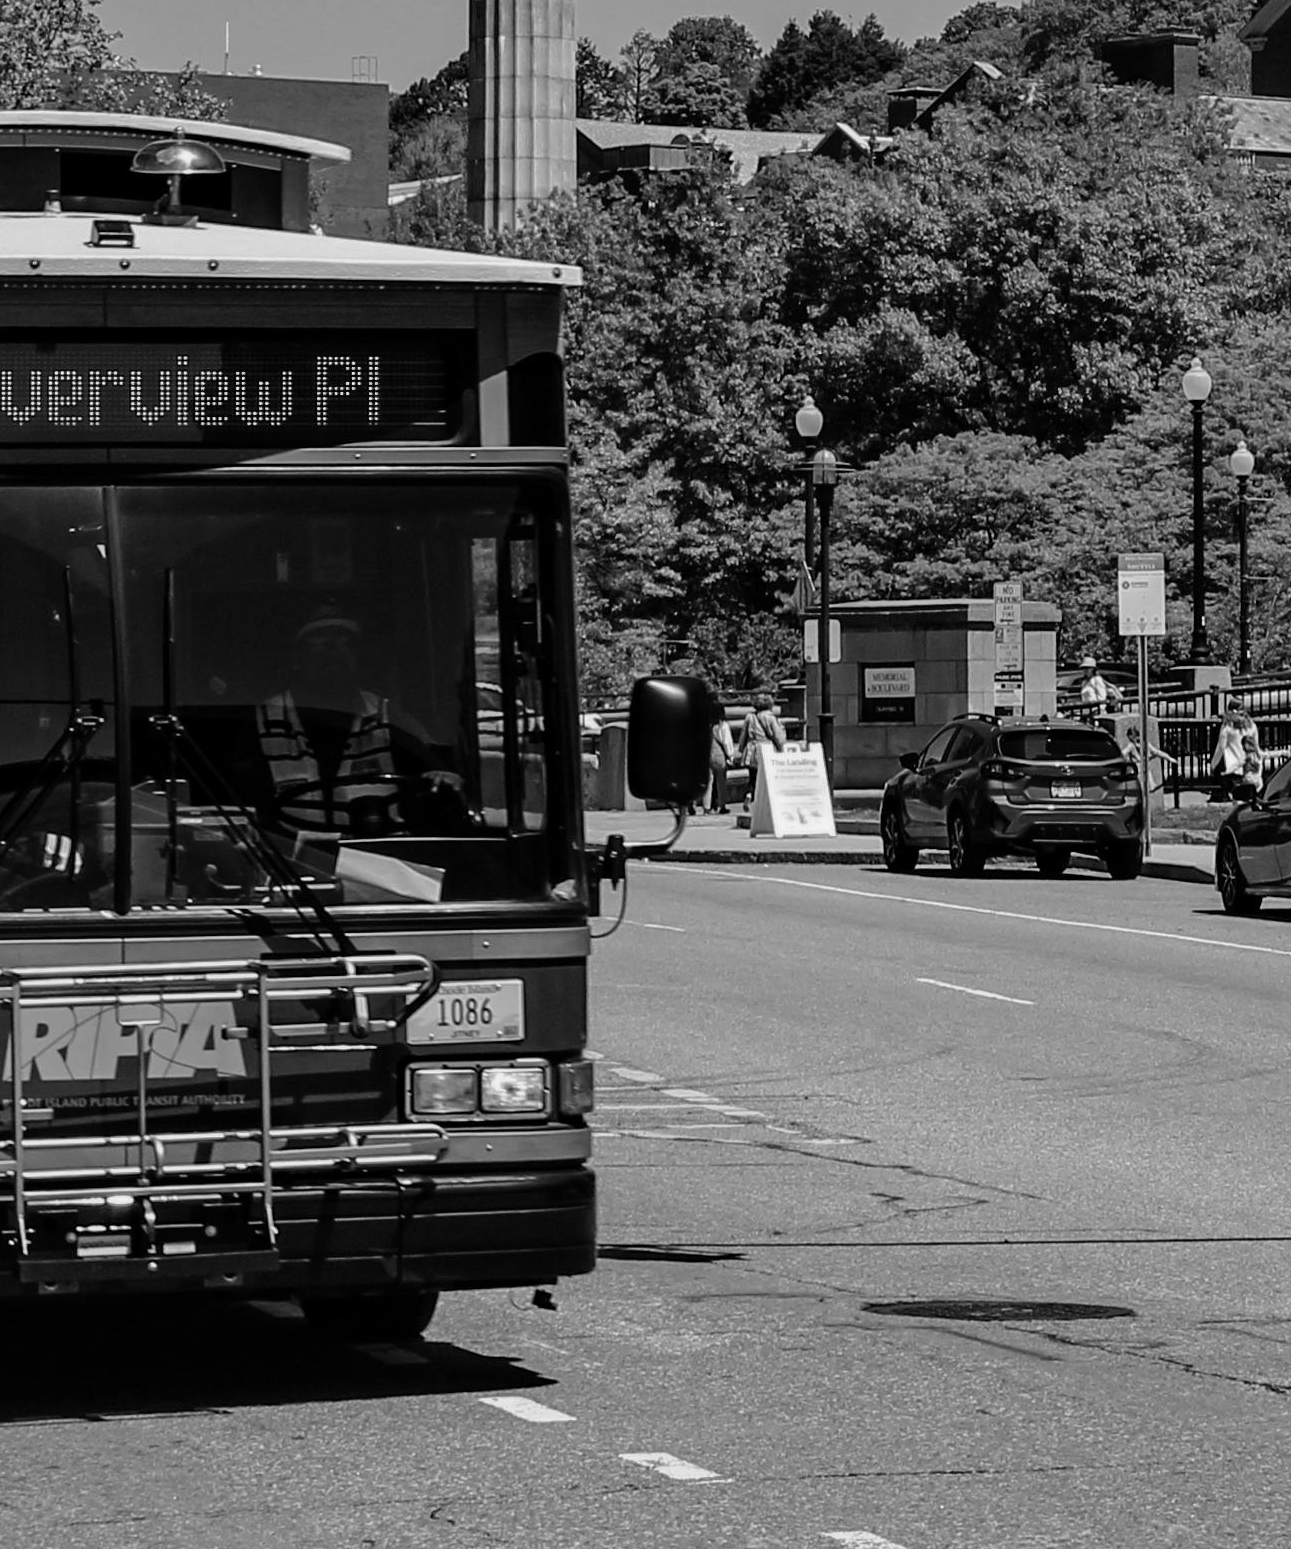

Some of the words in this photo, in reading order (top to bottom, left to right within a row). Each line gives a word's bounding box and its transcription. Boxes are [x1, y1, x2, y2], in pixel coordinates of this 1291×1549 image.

[1002, 586, 1014, 596] NO
[995, 596, 1021, 604] PARKING
[872, 672, 908, 682] MEMORIAL
[871, 683, 910, 693] BOULEVARD
[437, 997, 493, 1026] 1086
[45, 1097, 88, 1109] ISLAND
[89, 1095, 130, 1107] PUBLIC
[131, 1094, 179, 1107] TANSIT
